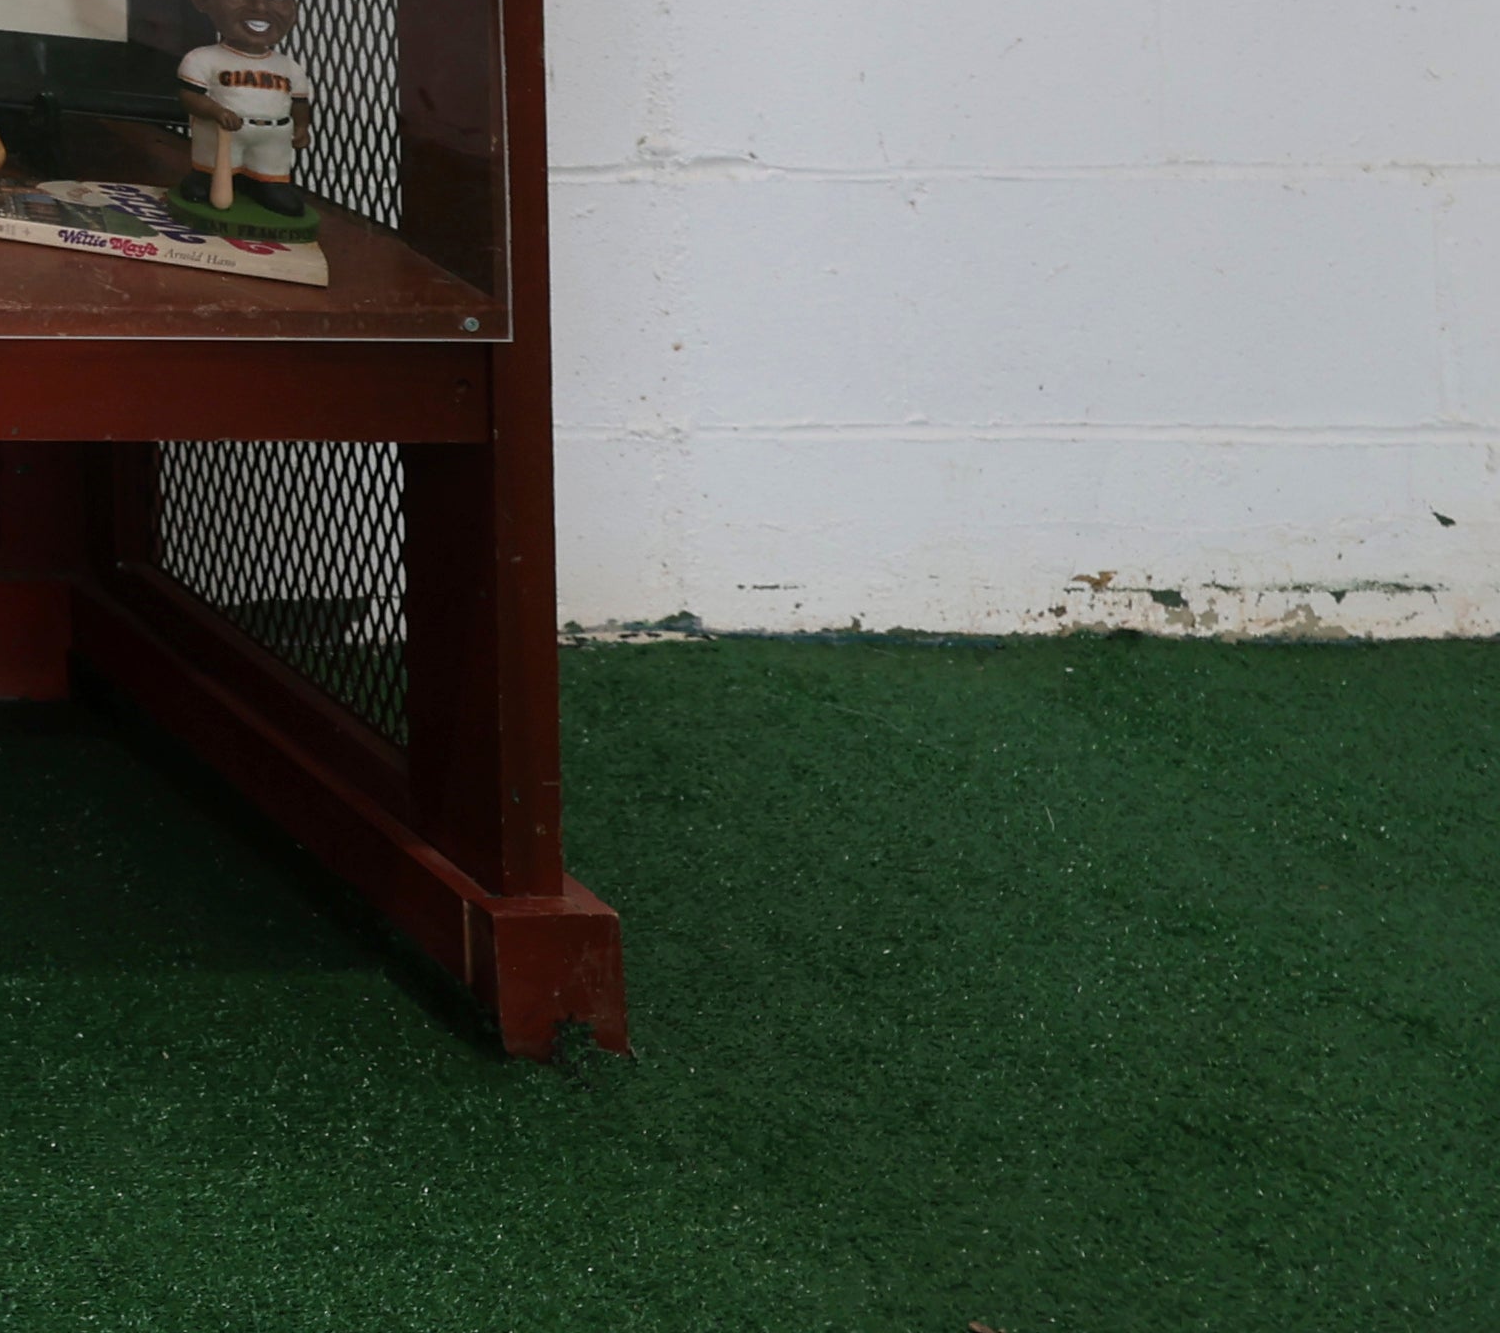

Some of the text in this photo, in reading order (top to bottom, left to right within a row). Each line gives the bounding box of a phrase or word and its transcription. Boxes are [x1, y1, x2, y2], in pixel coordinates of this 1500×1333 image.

[218, 69, 293, 94] GIANTS
[57, 228, 108, 249] Willie
[108, 236, 160, 260] Mays
